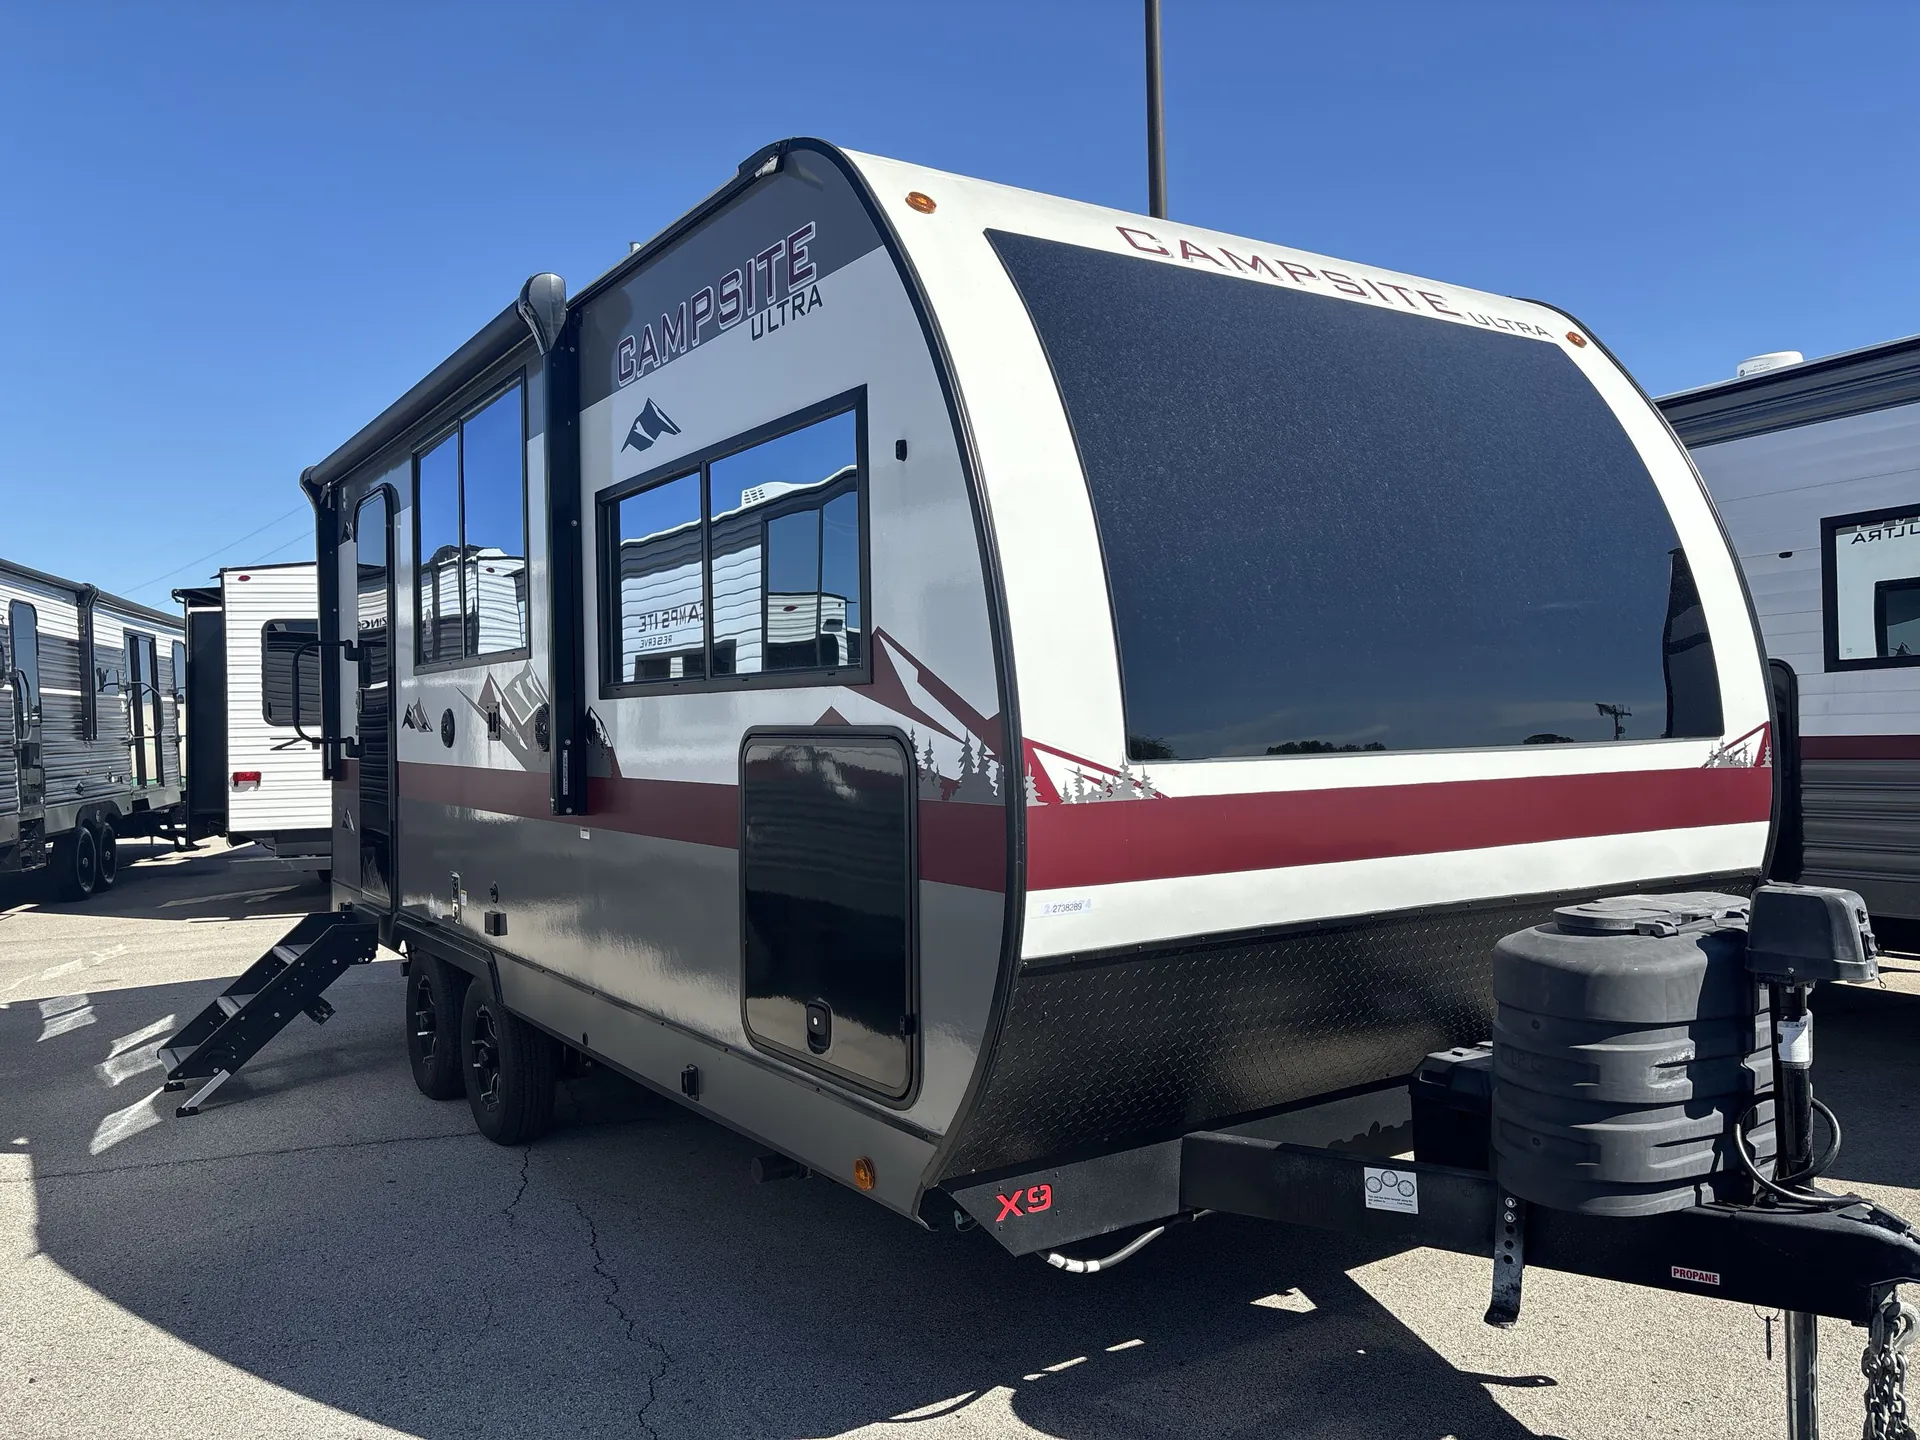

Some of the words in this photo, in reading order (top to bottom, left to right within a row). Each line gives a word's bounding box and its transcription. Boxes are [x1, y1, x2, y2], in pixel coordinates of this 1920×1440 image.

[618, 221, 816, 387] CAMPSITE
[1116, 226, 1464, 320] CAMPSITE
[1467, 312, 1554, 338] ULTRA
[751, 285, 823, 341] ULTRA
[996, 1184, 1052, 1222] X9
[1673, 1268, 1718, 1283] PROPANE
